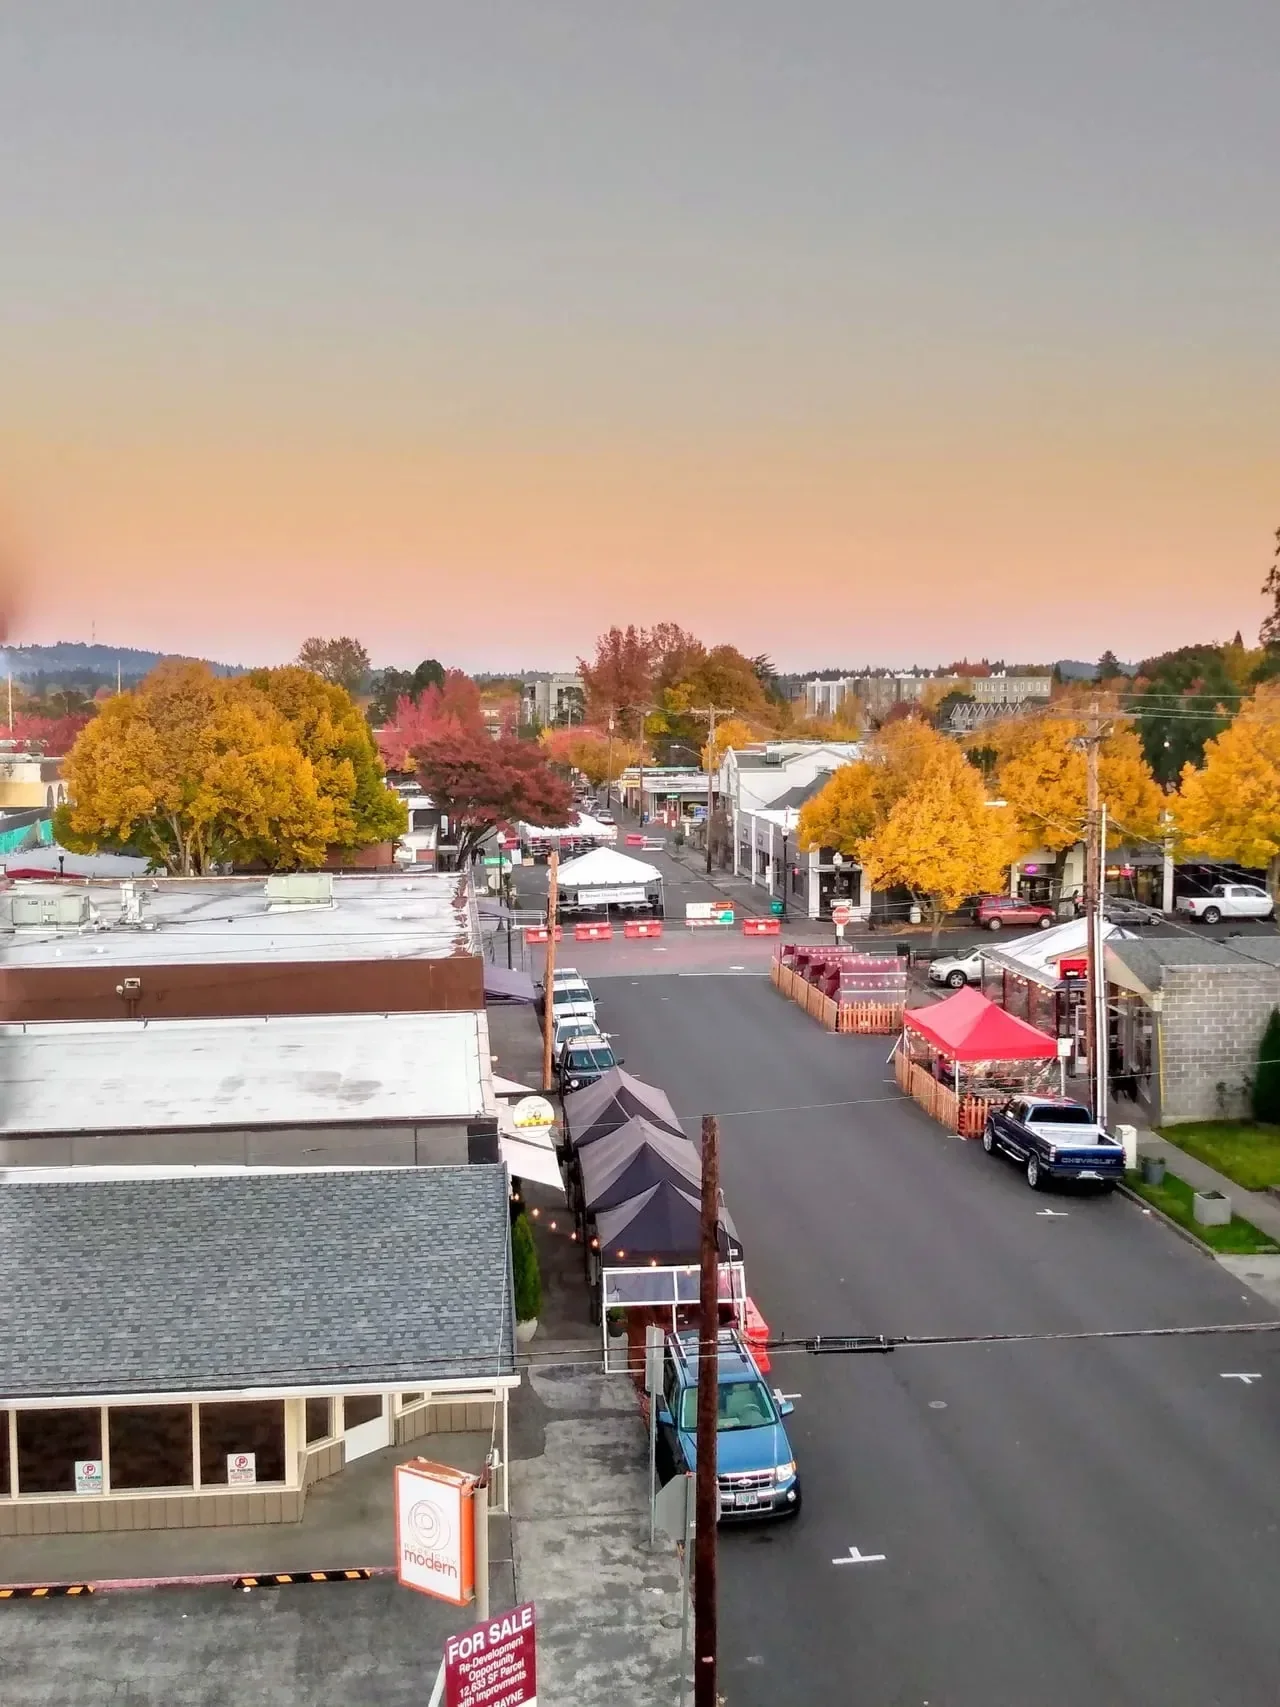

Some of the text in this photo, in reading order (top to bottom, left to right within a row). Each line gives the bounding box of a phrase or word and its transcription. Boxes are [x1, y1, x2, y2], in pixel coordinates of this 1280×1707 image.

[1061, 1157, 1117, 1165] CHEVROLET
[404, 1549, 458, 1579] modern
[448, 1607, 532, 1665] FOR SALE
[459, 1635, 524, 1675] Re-Development
[468, 1652, 515, 1682] Opportunity
[460, 1657, 525, 1698] 12,633 SF Parcel
[476, 1670, 527, 1702] Improvments
